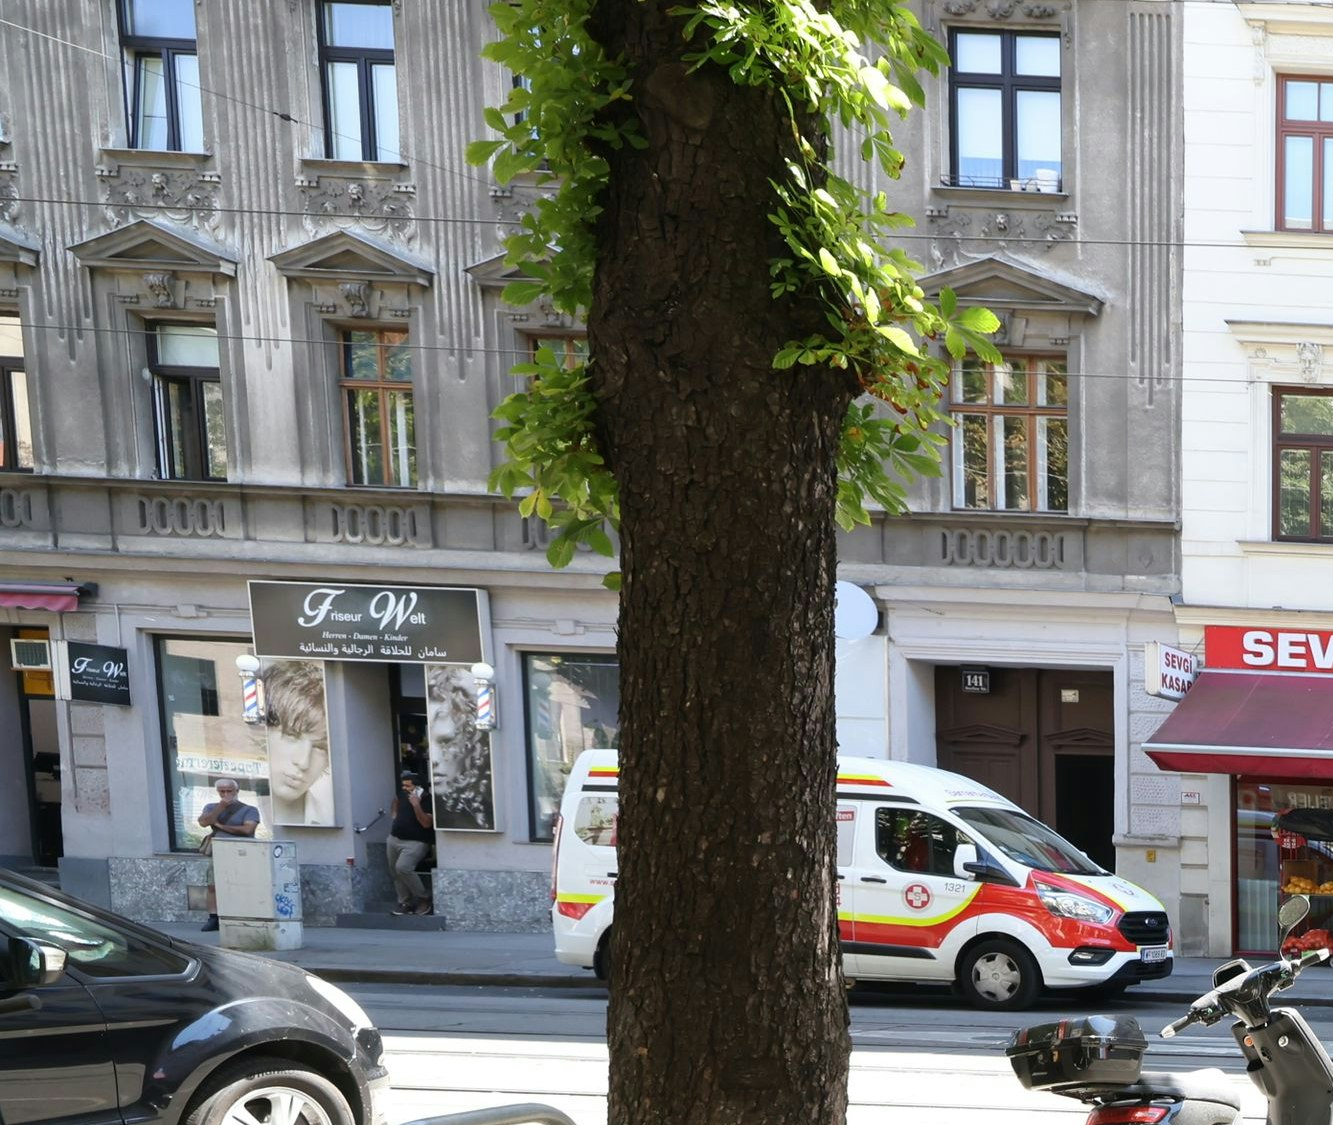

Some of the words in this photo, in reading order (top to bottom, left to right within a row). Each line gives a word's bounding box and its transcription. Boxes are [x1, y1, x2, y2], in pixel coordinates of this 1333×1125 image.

[298, 588, 362, 628] Friseur
[369, 591, 426, 631] Welt
[322, 631, 347, 639] Herren
[353, 632, 378, 641] Damen
[384, 633, 409, 642] Kinder
[966, 675, 983, 687] 141
[944, 882, 966, 893] 1321
